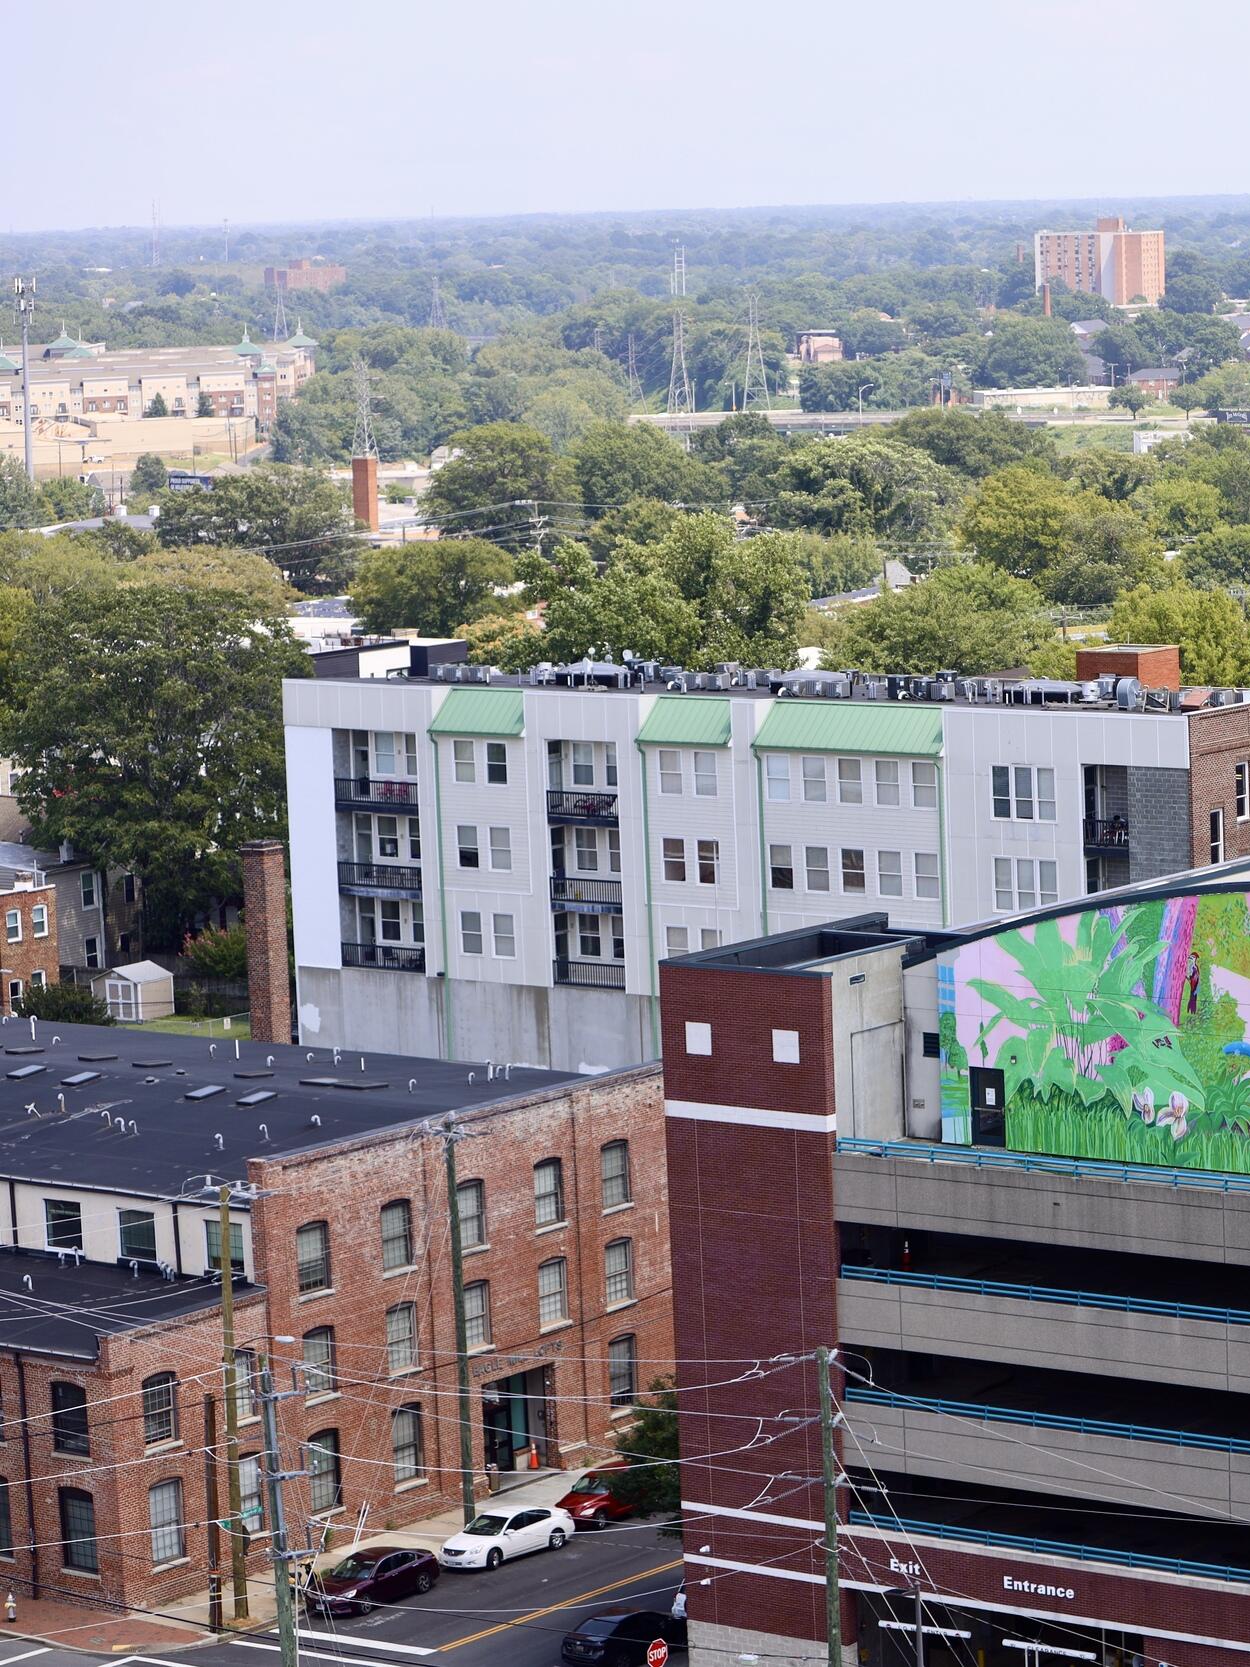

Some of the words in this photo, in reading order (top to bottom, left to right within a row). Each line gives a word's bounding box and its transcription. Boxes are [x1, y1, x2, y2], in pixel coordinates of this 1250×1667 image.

[890, 1558, 921, 1575] Exit
[1003, 1576, 1075, 1599] Entrance
[649, 1647, 667, 1662] STOP
